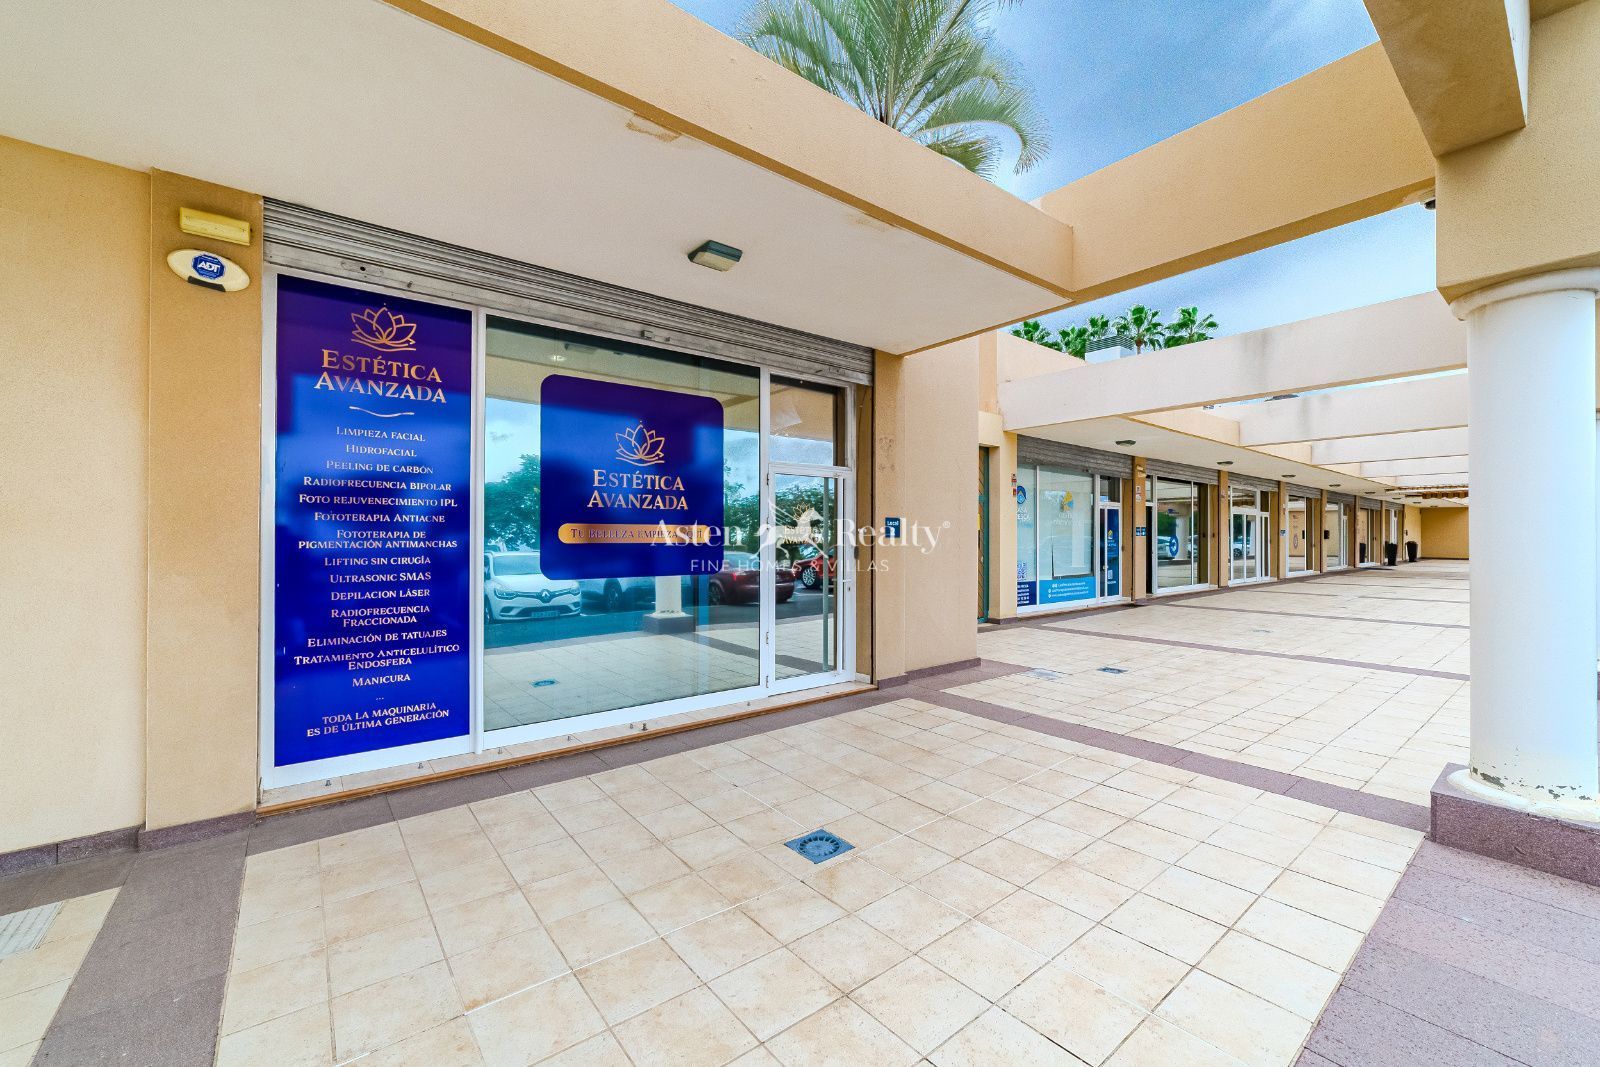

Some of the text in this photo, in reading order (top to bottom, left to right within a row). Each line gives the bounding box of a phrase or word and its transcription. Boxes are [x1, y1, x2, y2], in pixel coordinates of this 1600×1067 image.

[198, 261, 220, 273] ADT
[322, 349, 442, 382] ESTÉTICA
[313, 371, 447, 403] AVANZADA
[336, 426, 426, 442] LIMPIEZA FACIAL
[346, 444, 417, 457] HIDROFACIAL
[326, 460, 434, 474] PEELING DE CARBÓN
[303, 476, 452, 491] RADIOFRECUENCIA BIPOLAR
[593, 469, 685, 490] ESTÉTICA
[299, 494, 458, 507] FOTO REJUVENECIMIENTO IPL
[587, 489, 689, 510] AVANZADA
[314, 512, 446, 523] FOTOTERAPIA ANTIACNE
[337, 529, 427, 539] FOTOTERAPIA DE
[588, 529, 634, 538] BELLEZA
[298, 539, 458, 549] PIGMENTACIÓN ANTIMANCHAS
[324, 555, 431, 566] LIFTING SIN CIRUGÍA
[330, 572, 432, 584] ULTRASONIC SMAS
[331, 588, 430, 601] DEPILACION LÁSER
[331, 605, 430, 618] RADIOFRECUENCIA
[343, 615, 417, 628] FRACCIONADA
[307, 629, 447, 648] ELIMINACIÓN DE TATUAJES
[294, 643, 460, 666] TRATAMIENTO ANTICELULÍTICO
[348, 656, 412, 671] ENDOSFERA
[352, 673, 411, 688] MANICURA
[322, 702, 437, 725] TODA LA MAQUINARIA
[306, 709, 449, 737] ES DE ÚLTIMA GENERACIÓN
